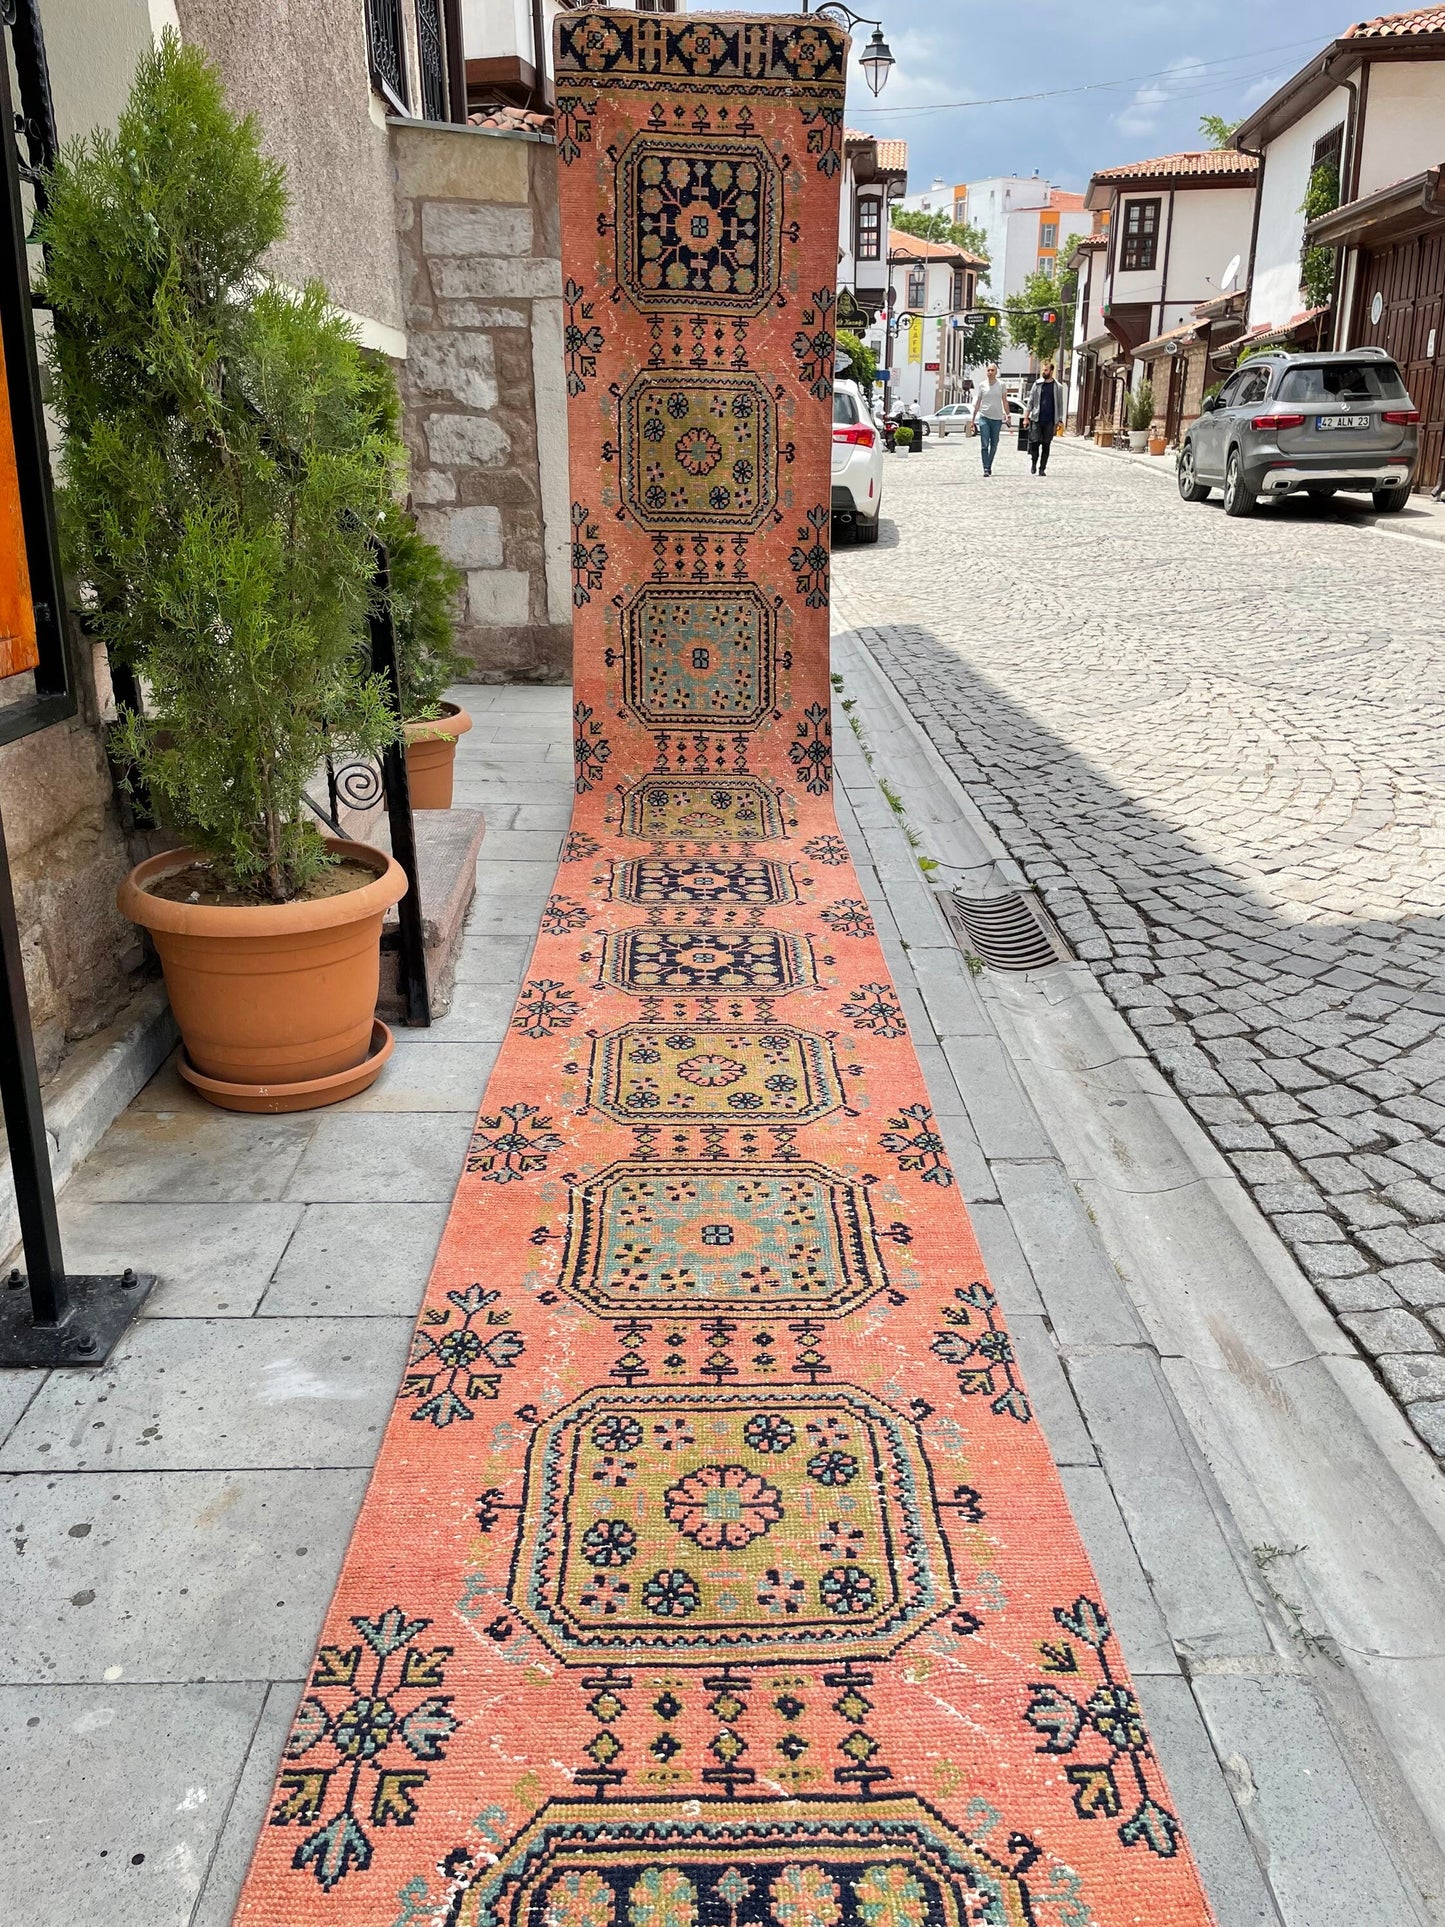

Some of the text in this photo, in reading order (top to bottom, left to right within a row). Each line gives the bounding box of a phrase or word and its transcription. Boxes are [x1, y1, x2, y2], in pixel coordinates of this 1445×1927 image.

[1321, 416, 1369, 427] 42 ALN 23
